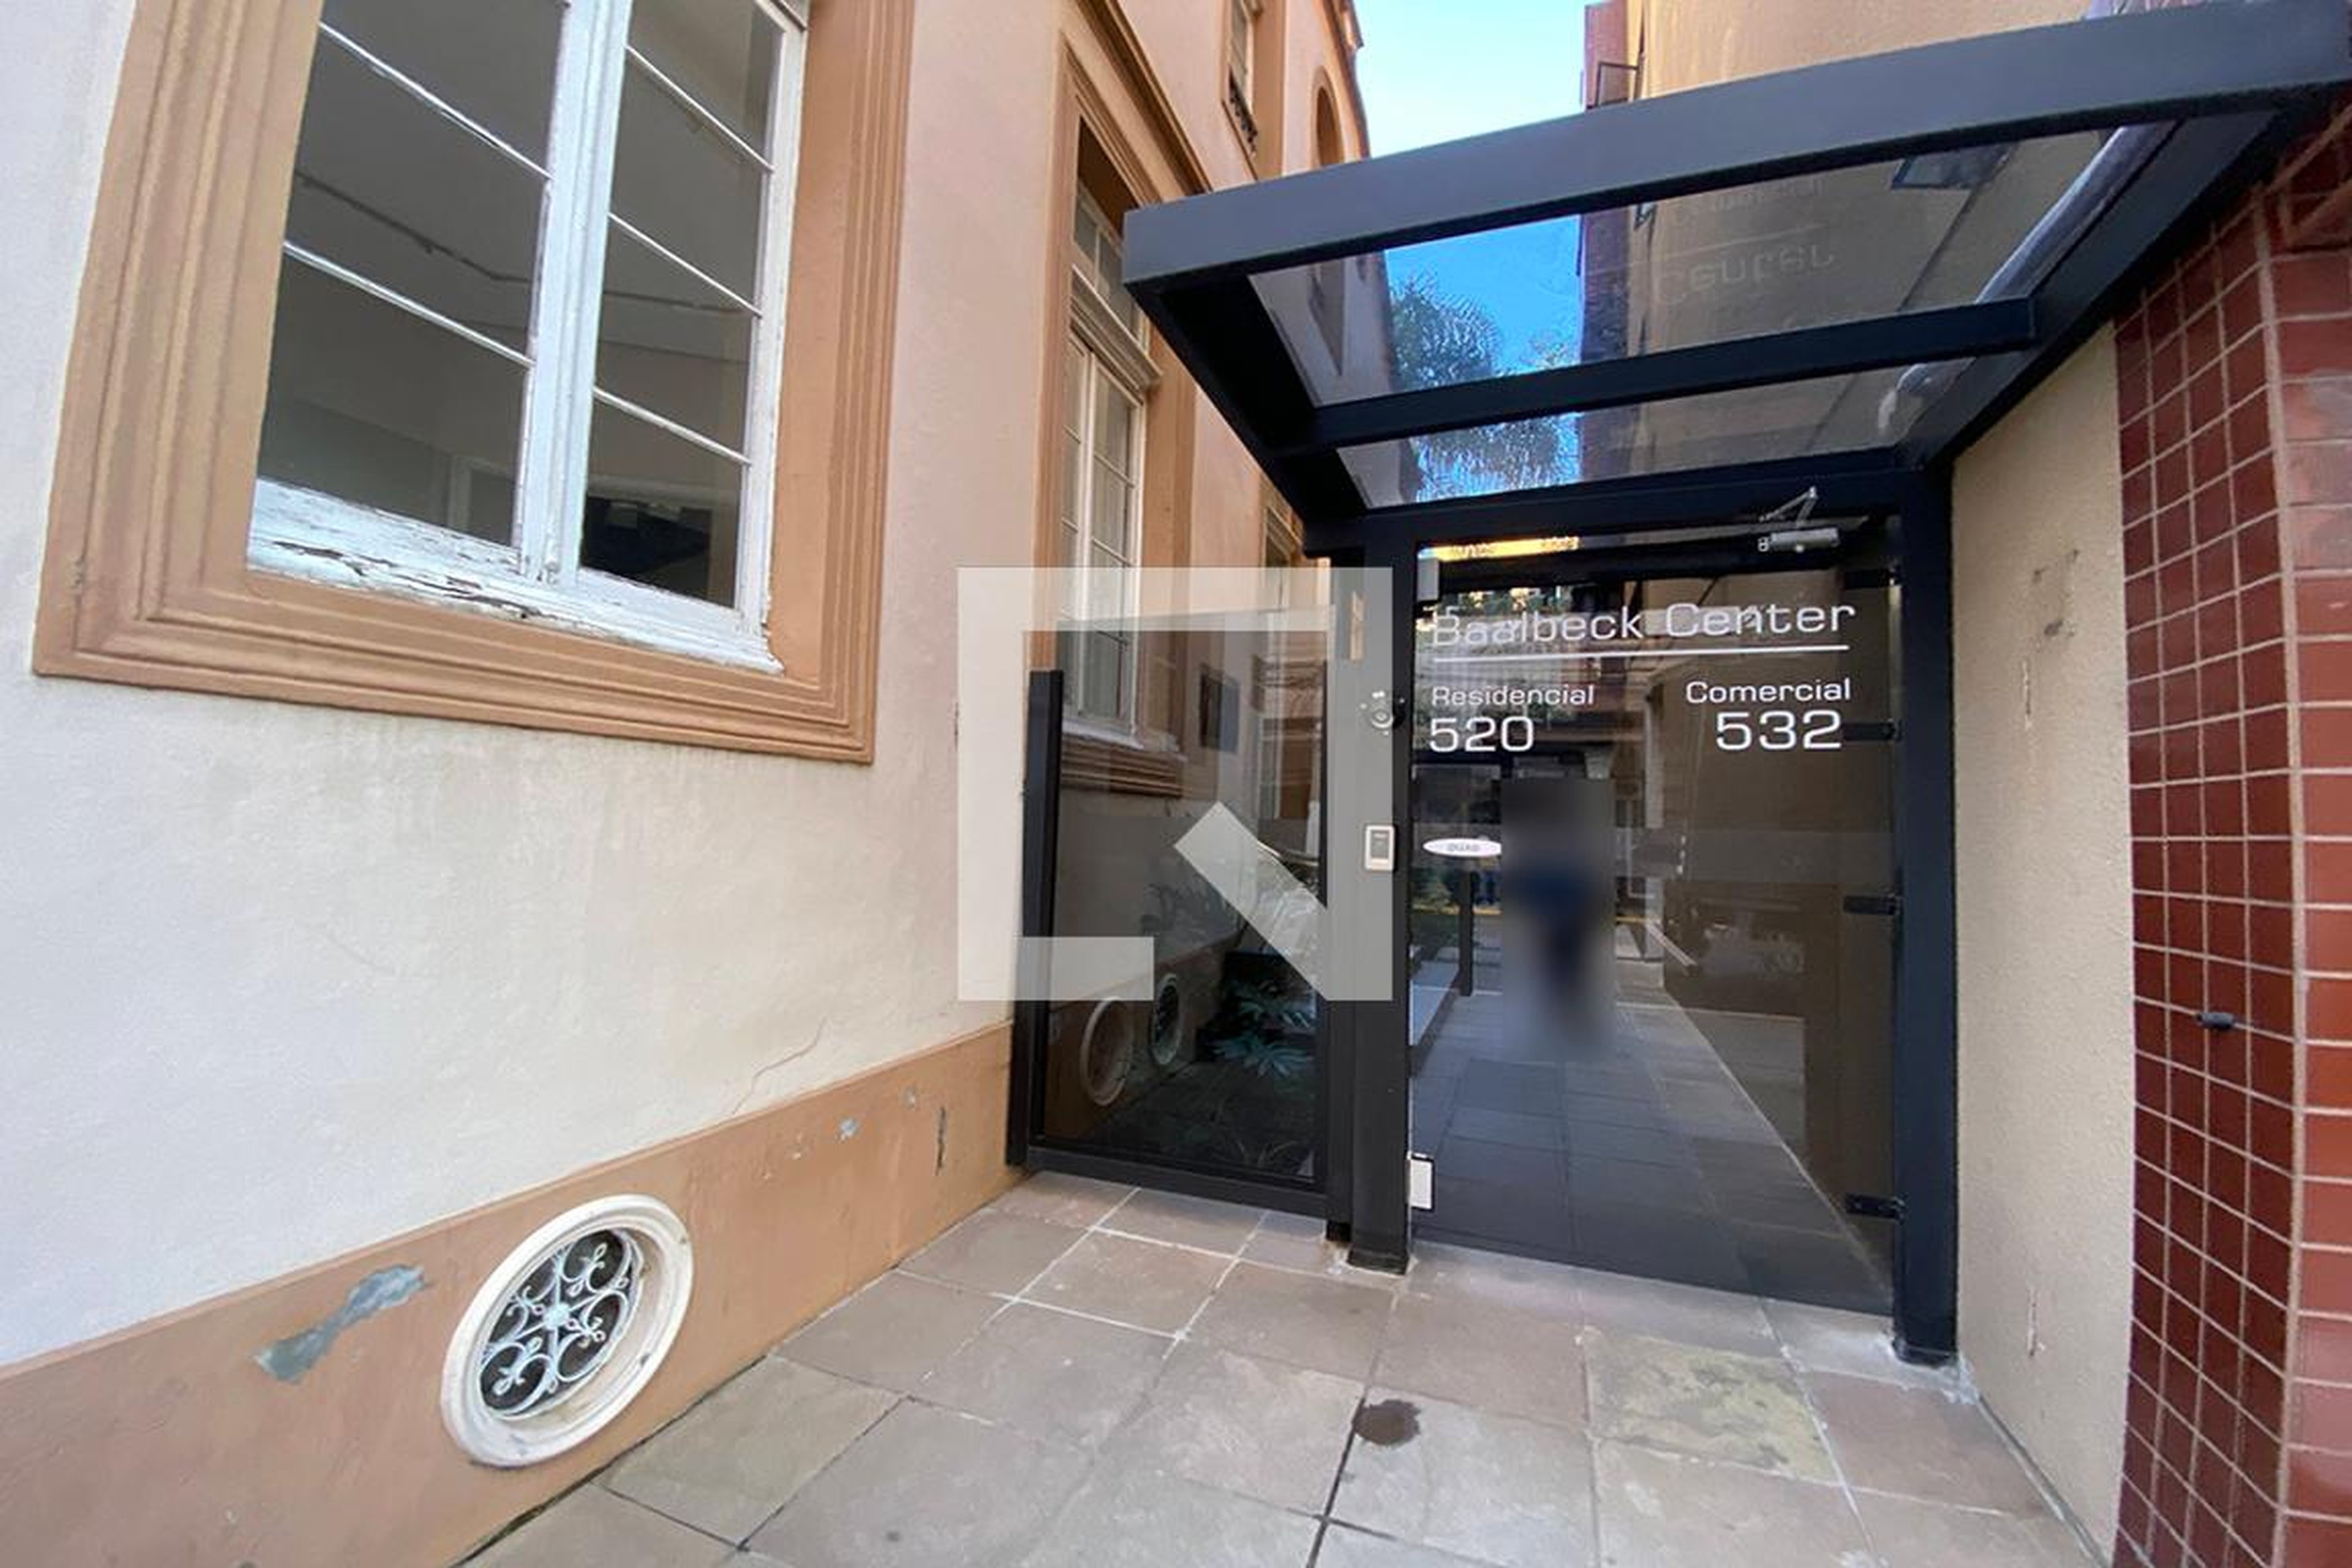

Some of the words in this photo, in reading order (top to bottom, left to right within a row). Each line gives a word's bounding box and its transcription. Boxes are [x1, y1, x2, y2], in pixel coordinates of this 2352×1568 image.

[1433, 606, 1645, 647] Baalbeck
[1666, 603, 1856, 637] Center
[1431, 684, 1594, 706] Residencial
[1686, 677, 1850, 704] Comercial
[1429, 715, 1534, 753] 520
[1716, 709, 1842, 750] 532
